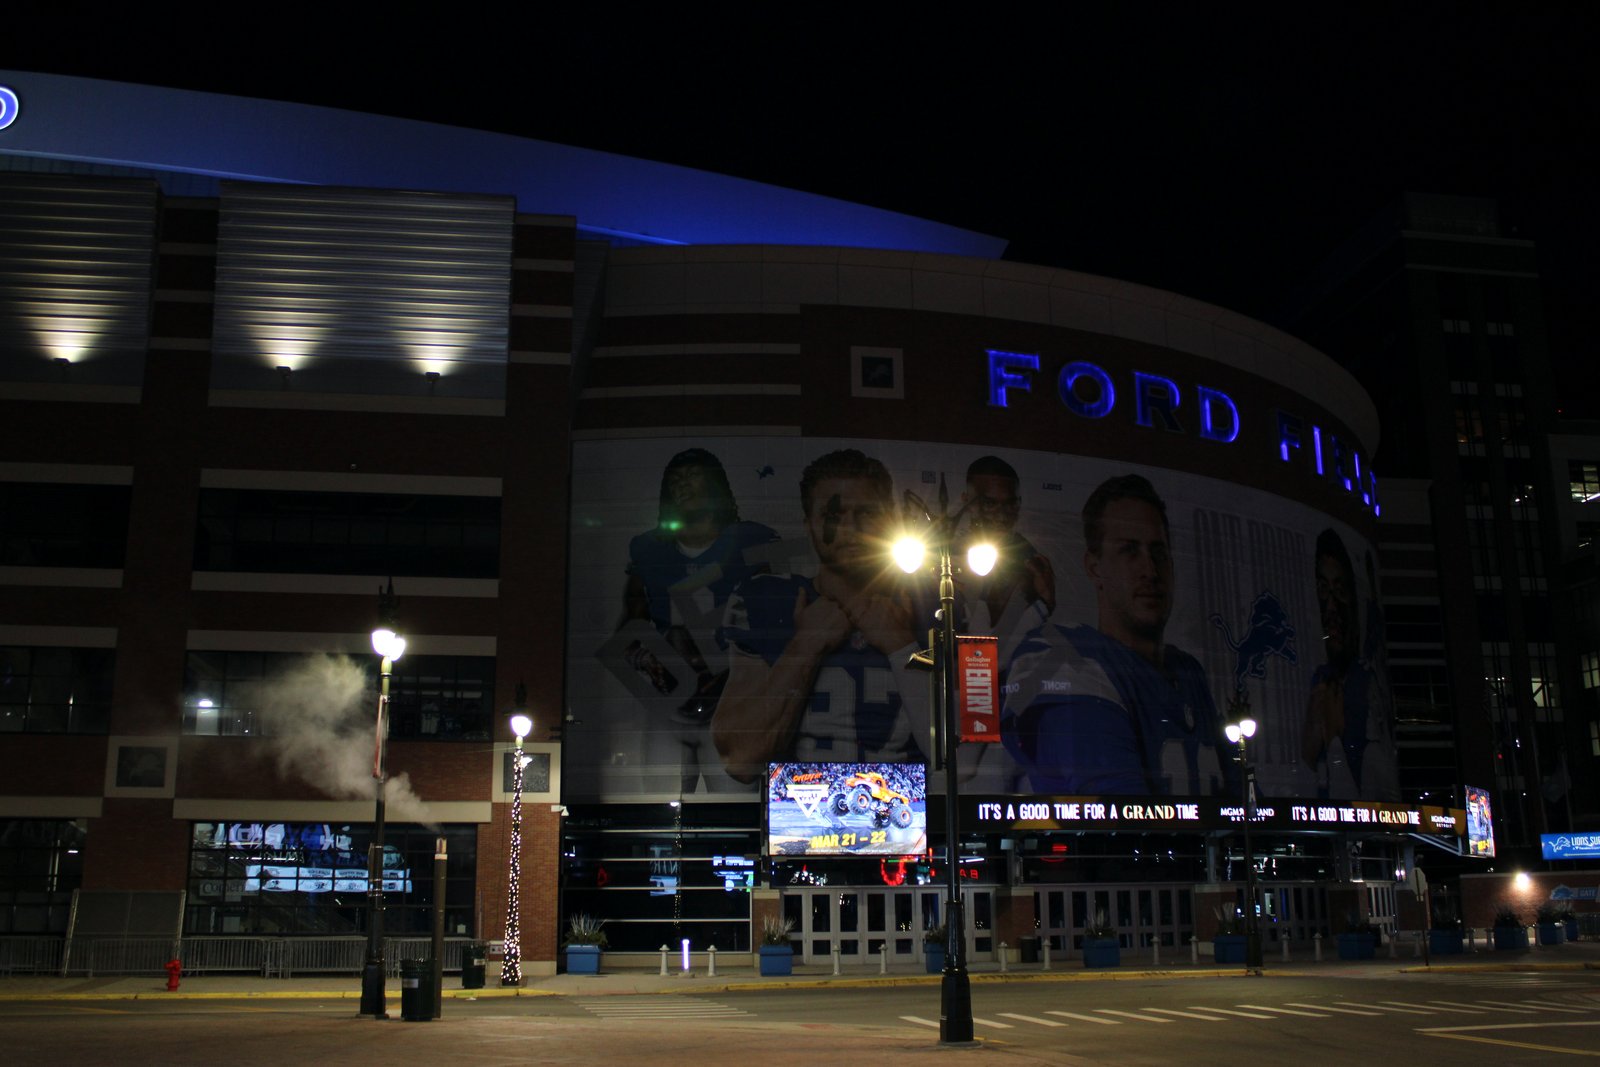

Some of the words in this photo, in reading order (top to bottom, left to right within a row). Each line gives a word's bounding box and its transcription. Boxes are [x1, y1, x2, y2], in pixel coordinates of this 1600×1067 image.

[985, 349, 1240, 443] FORD
[1275, 407, 1381, 517] FIELD
[965, 669, 993, 715] ENTRY
[978, 803, 1001, 820] IT'S
[1006, 803, 1015, 820] A
[1019, 803, 1050, 820] GOOD
[1054, 803, 1081, 820] TIME
[1084, 803, 1106, 820] FOR
[1110, 803, 1119, 820] A
[1122, 804, 1175, 820] GRAND
[1176, 804, 1199, 820] TIME
[1292, 805, 1308, 821] IT'S
[1310, 806, 1316, 821] A
[1318, 807, 1337, 821] GOOD
[1339, 807, 1355, 822] TIME
[1357, 808, 1371, 822] FOR
[1372, 809, 1378, 823] A
[1379, 810, 1407, 824] GRAND
[1407, 811, 1421, 825] TIME
[810, 834, 839, 848] MAR
[841, 833, 856, 847] 21
[870, 831, 887, 844] 22
[1571, 836, 1589, 846] LIONS
